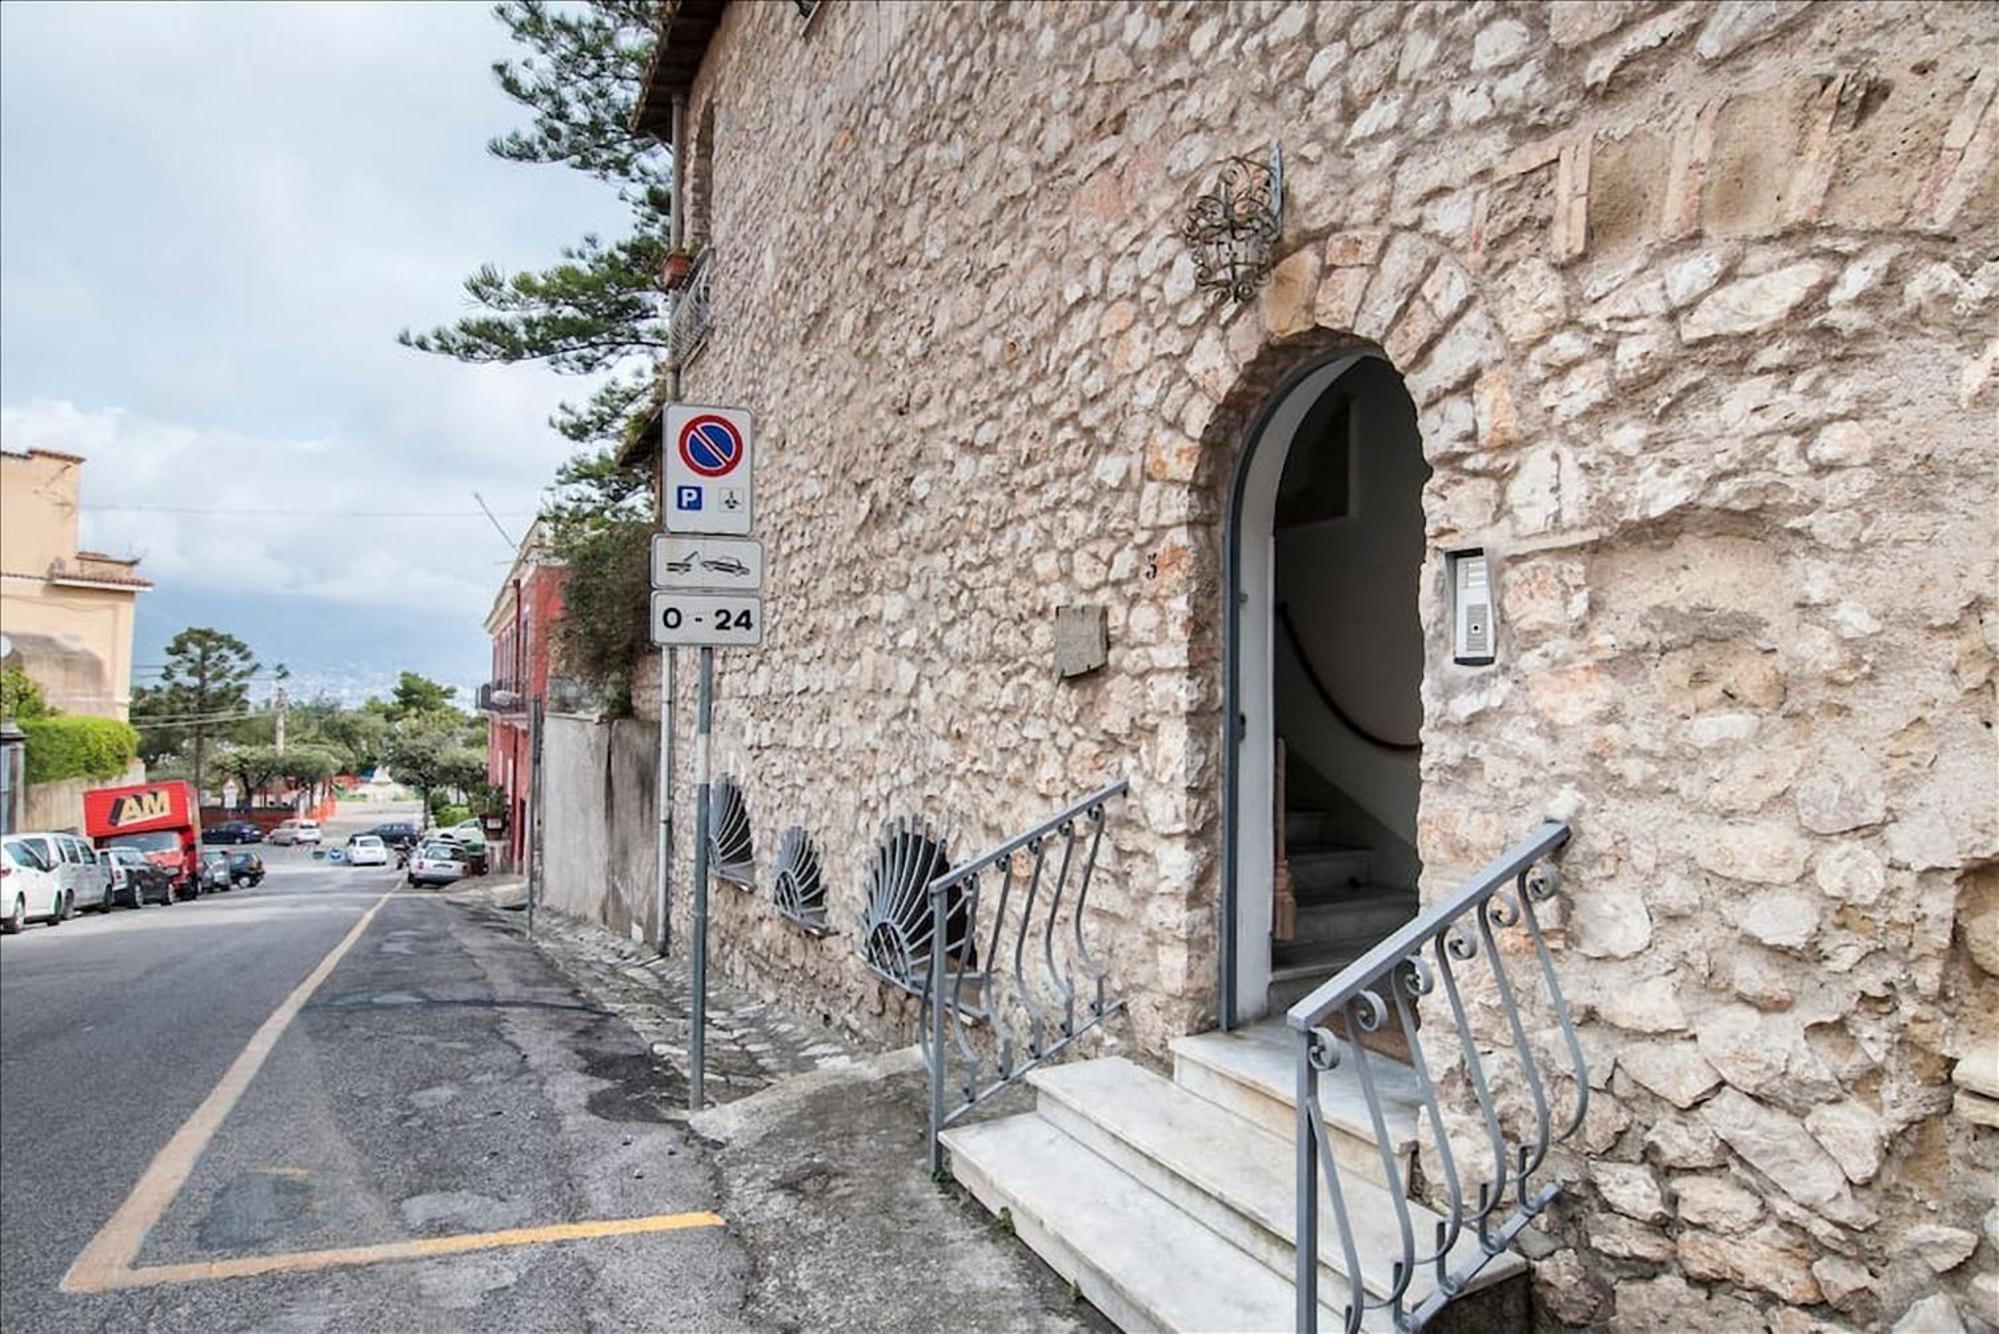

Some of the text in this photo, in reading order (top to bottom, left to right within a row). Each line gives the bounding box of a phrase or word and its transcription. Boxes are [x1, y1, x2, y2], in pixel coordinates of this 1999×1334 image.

[681, 488, 698, 508] P
[715, 609, 753, 631] 24
[110, 790, 172, 827] AM
